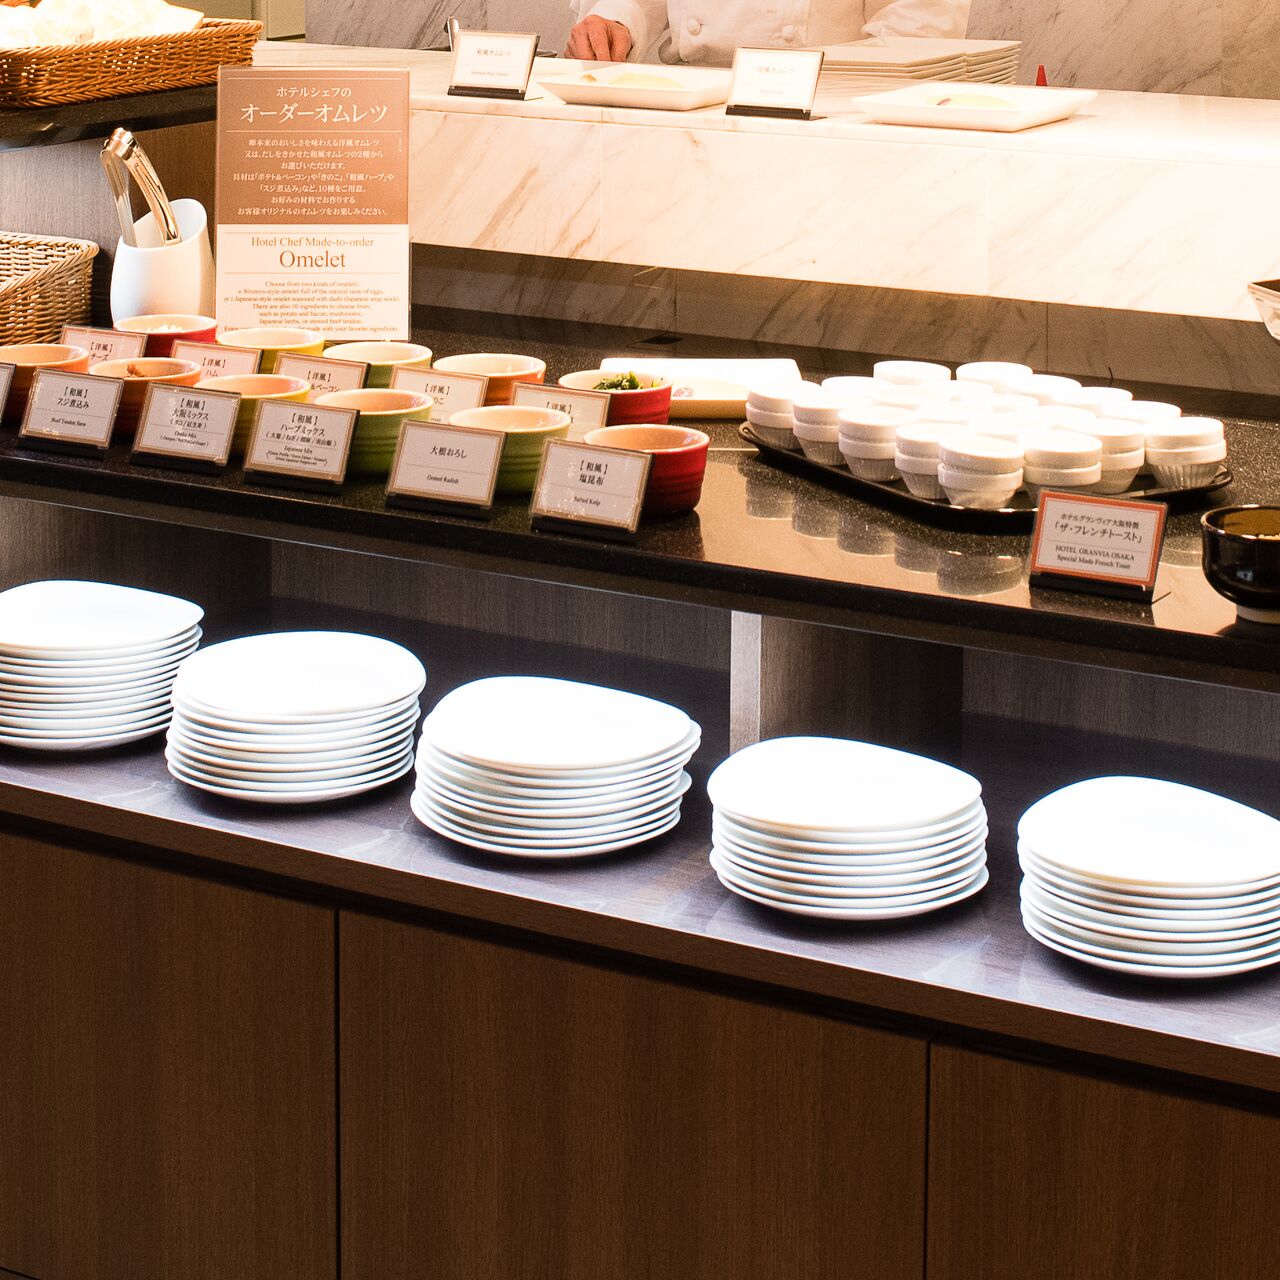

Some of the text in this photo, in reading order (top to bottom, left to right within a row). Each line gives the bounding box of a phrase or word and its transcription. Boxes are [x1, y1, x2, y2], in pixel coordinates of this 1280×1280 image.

[276, 86, 352, 98] ホテルシェフの
[240, 103, 388, 123] オーダーオムレツ
[251, 237, 375, 247] Hotel Chef Made-to-order
[279, 250, 346, 268] Omelet
[90, 342, 113, 353] 【洋風】
[90, 352, 108, 362] チーズ
[202, 357, 226, 368] 【洋風】
[308, 370, 332, 382] 【洋風】
[64, 386, 88, 398] 【和風】
[424, 384, 450, 396] 【洋風】
[180, 397, 206, 410] 【和風】
[171, 408, 209, 420] 大阪ミックス
[291, 412, 318, 426] 【和風】
[280, 423, 326, 437] ハーブミックス
[430, 445, 468, 459] 大根おろし
[580, 460, 608, 475] 【和風】
[443, 475, 460, 484] Radish
[578, 472, 604, 486] 塩昆布
[1060, 513, 1140, 530] ホテルグランヴィア大阪特製
[1054, 522, 1142, 544] 「ザ・フレンチトースト」
[1055, 545, 1135, 561] HOTEL GRANVIA OSAKA
[1056, 554, 1078, 563] Special
[1094, 559, 1114, 568] French
[1115, 561, 1131, 570] Toast
